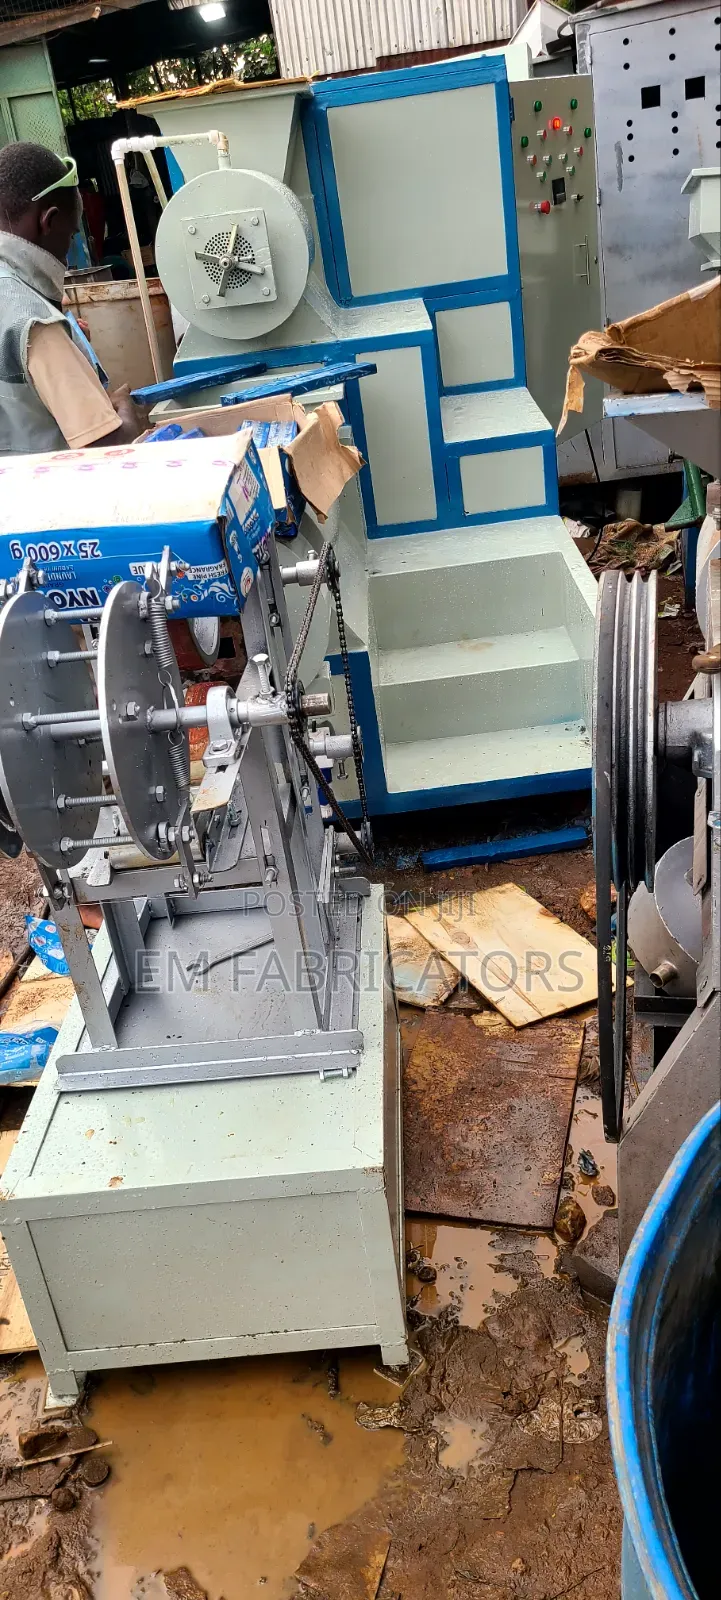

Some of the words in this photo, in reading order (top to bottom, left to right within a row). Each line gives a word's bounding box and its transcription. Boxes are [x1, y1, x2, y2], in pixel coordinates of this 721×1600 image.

[9, 540, 24, 561] g
[26, 542, 61, 563] 600
[60, 540, 78, 558] x
[77, 539, 102, 561] 25
[188, 562, 226, 574] FRAGRANCE
[192, 572, 208, 580] PINE
[208, 568, 228, 579] FRESH
[45, 586, 102, 610] NYO
